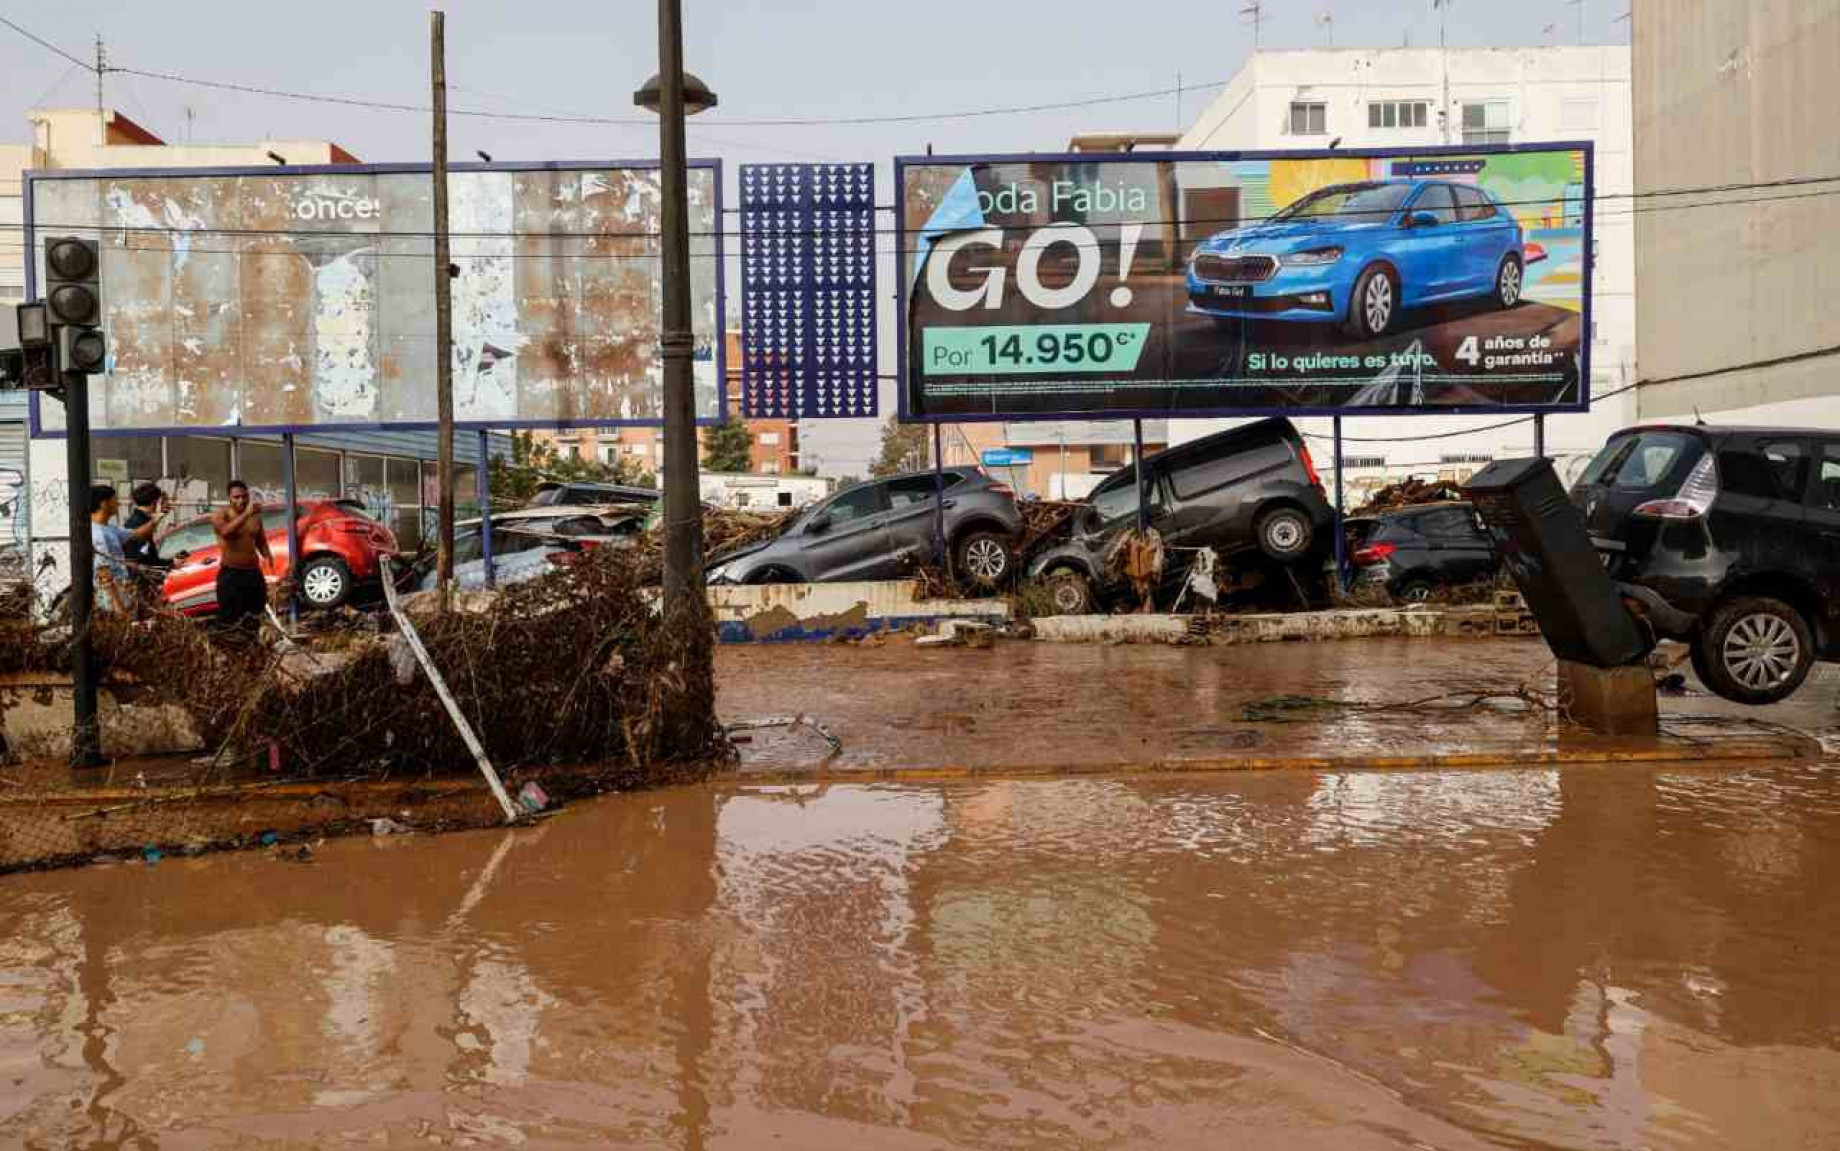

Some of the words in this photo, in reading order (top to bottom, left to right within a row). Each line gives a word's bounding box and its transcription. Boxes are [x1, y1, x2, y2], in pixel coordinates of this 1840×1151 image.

[975, 182, 1037, 214] oda
[1053, 181, 1145, 213] Fabia
[926, 222, 1143, 310] GO!
[933, 345, 973, 366] Por
[1249, 353, 1266, 369] Si
[1271, 353, 1288, 369] lo
[1293, 351, 1360, 372] quieres
[1364, 354, 1386, 368] es
[1454, 336, 1480, 366] 4
[1484, 336, 1525, 349] años
[1529, 335, 1552, 347] de
